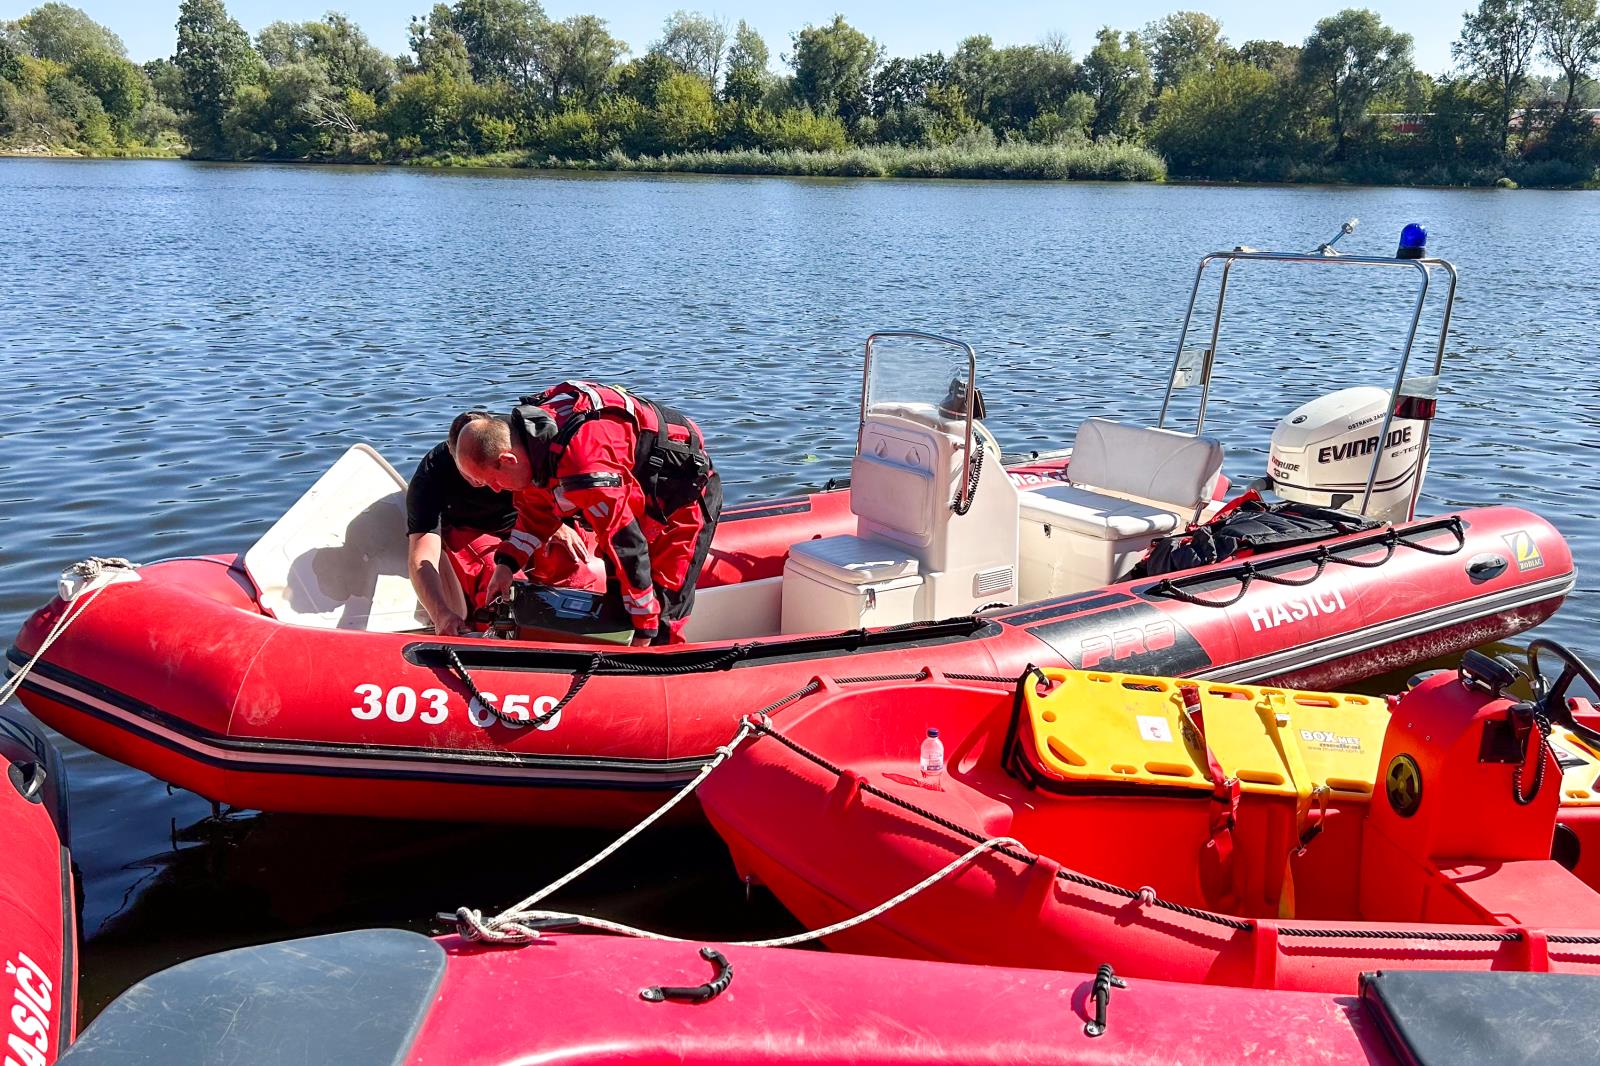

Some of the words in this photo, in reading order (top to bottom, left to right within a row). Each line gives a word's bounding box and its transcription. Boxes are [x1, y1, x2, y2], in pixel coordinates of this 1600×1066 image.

[1348, 418, 1374, 430] OSTRAVA
[1519, 558, 1542, 570] ZODIAC
[1081, 619, 1176, 669] PRO
[351, 683, 449, 725] 303
[468, 692, 562, 731] 659
[1300, 729, 1336, 743] BOX
[4, 951, 53, 1066] ASIČI
